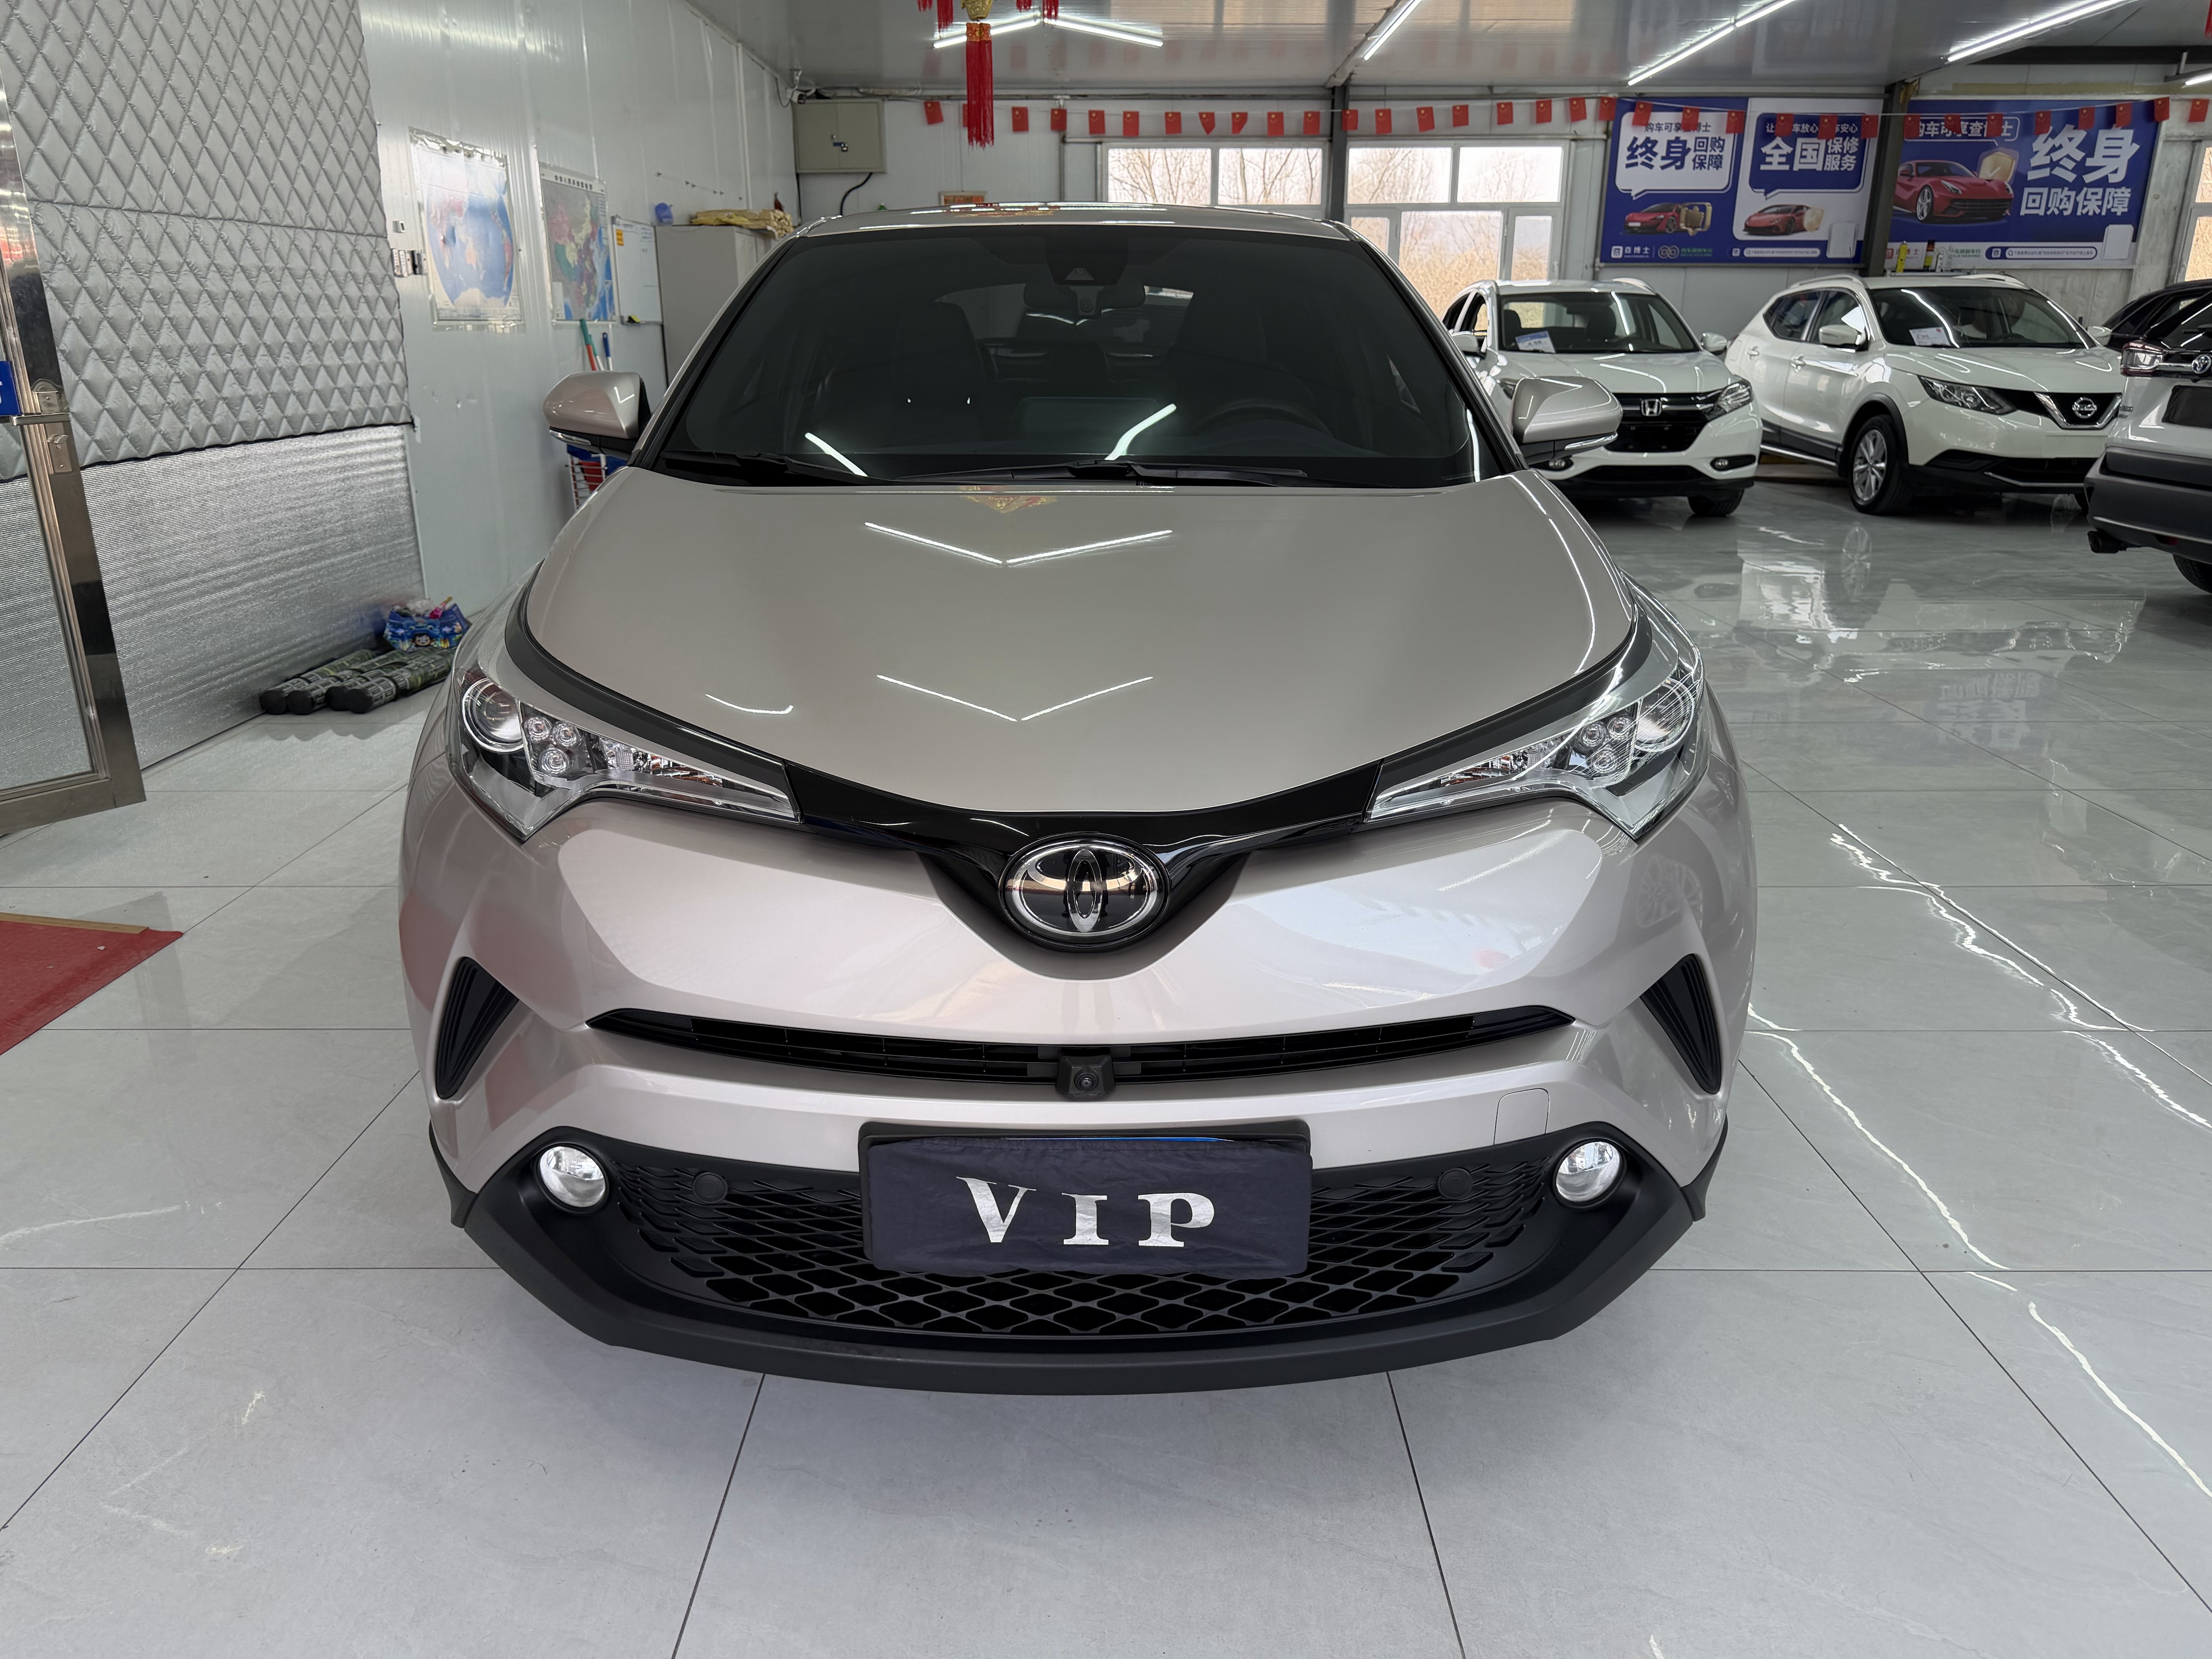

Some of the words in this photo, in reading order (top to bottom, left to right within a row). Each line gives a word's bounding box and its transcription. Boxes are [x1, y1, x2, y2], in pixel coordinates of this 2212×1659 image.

[1625, 136, 1692, 170] 终身
[1693, 136, 1725, 153] 回购
[1760, 136, 1826, 171] 全国
[1827, 136, 1859, 154] 保修
[2027, 124, 2140, 183] 终身
[1692, 154, 1723, 170] 保障
[1824, 154, 1856, 171] 服务
[2020, 187, 2131, 216] 回购保障
[955, 1176, 1215, 1247] VIP
